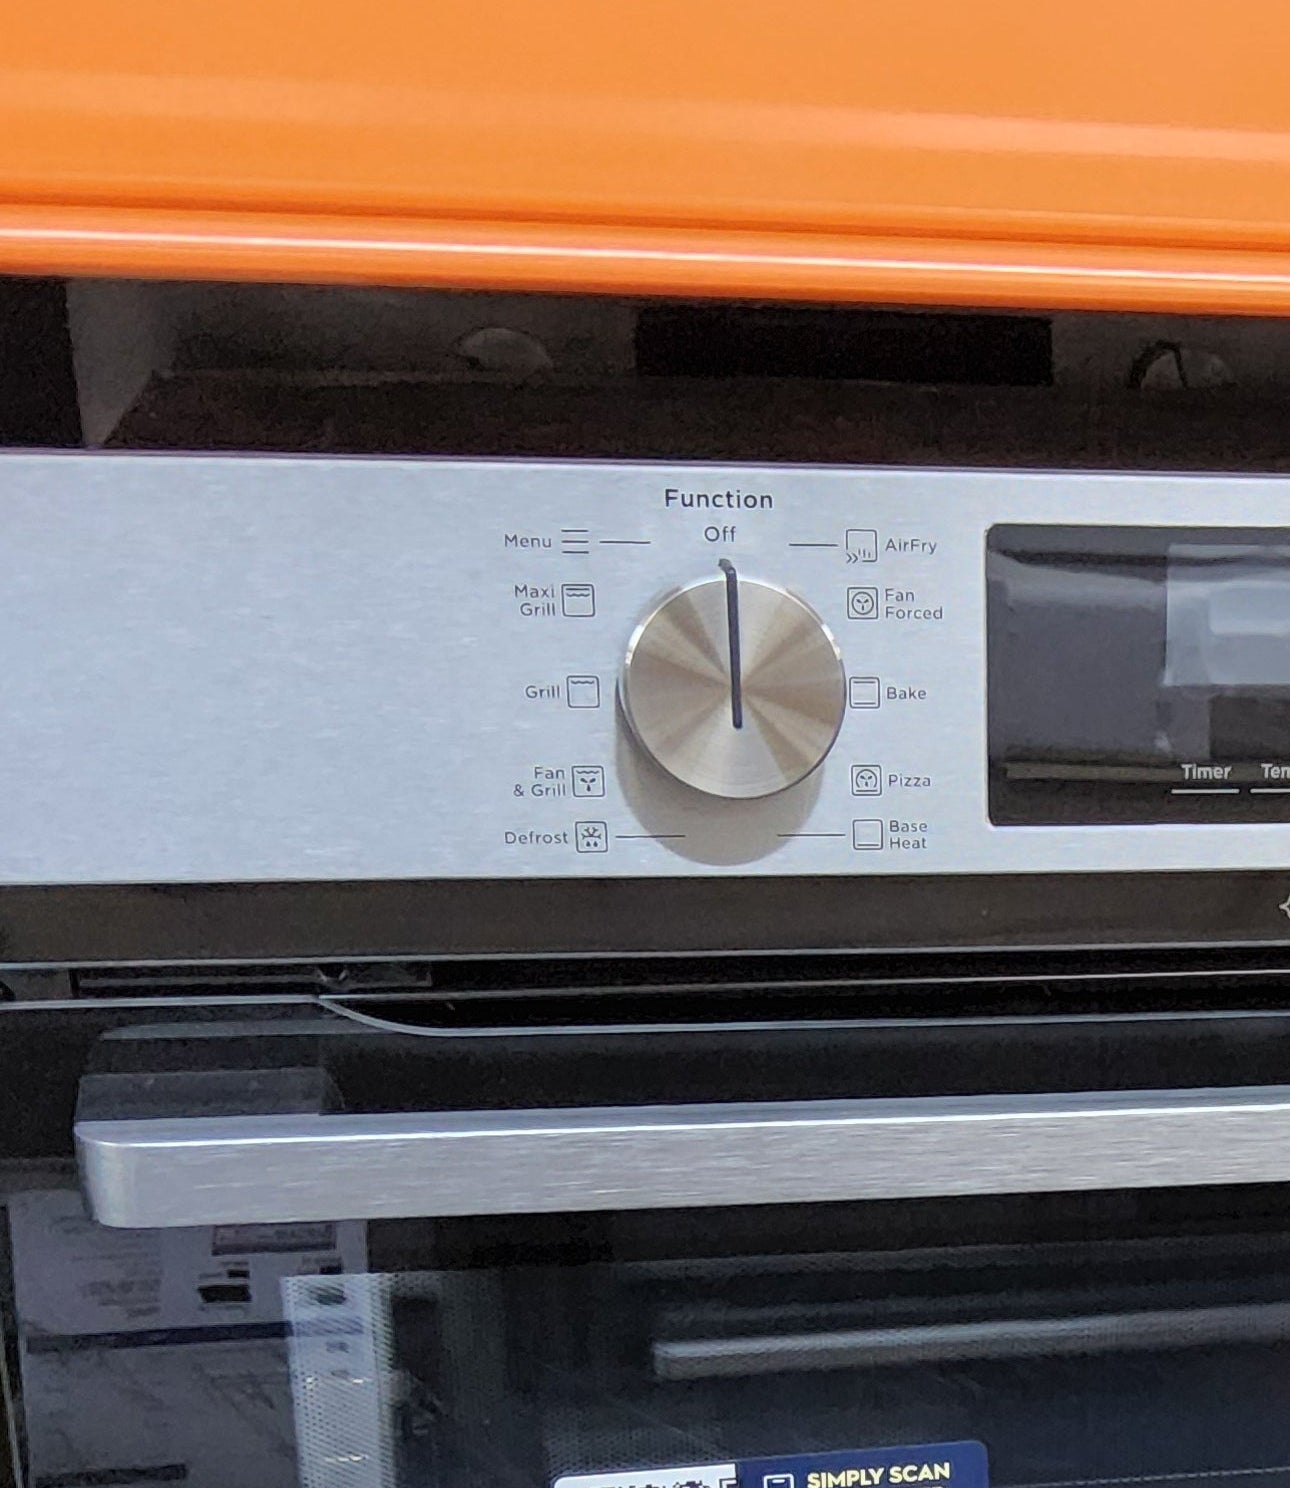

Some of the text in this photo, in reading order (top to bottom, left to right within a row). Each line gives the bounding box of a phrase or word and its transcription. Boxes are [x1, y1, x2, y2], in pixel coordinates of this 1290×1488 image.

[664, 488, 773, 509] Function
[504, 534, 552, 549] Menu
[703, 525, 737, 543] Off
[884, 538, 937, 555] AirFry
[514, 583, 555, 599] Maxi
[885, 589, 915, 602] Fan
[520, 602, 556, 617] Grill
[885, 606, 944, 621] Forced
[525, 684, 561, 700] Grill
[886, 686, 927, 701] Bake
[534, 766, 565, 780] Fan
[1181, 763, 1232, 780] Timer
[888, 773, 932, 788] Pizza
[513, 783, 566, 797] & Grill
[889, 819, 928, 833] Base
[504, 830, 569, 845] Defrost
[889, 836, 928, 850] Heat
[889, 1462, 950, 1483] SCAN
